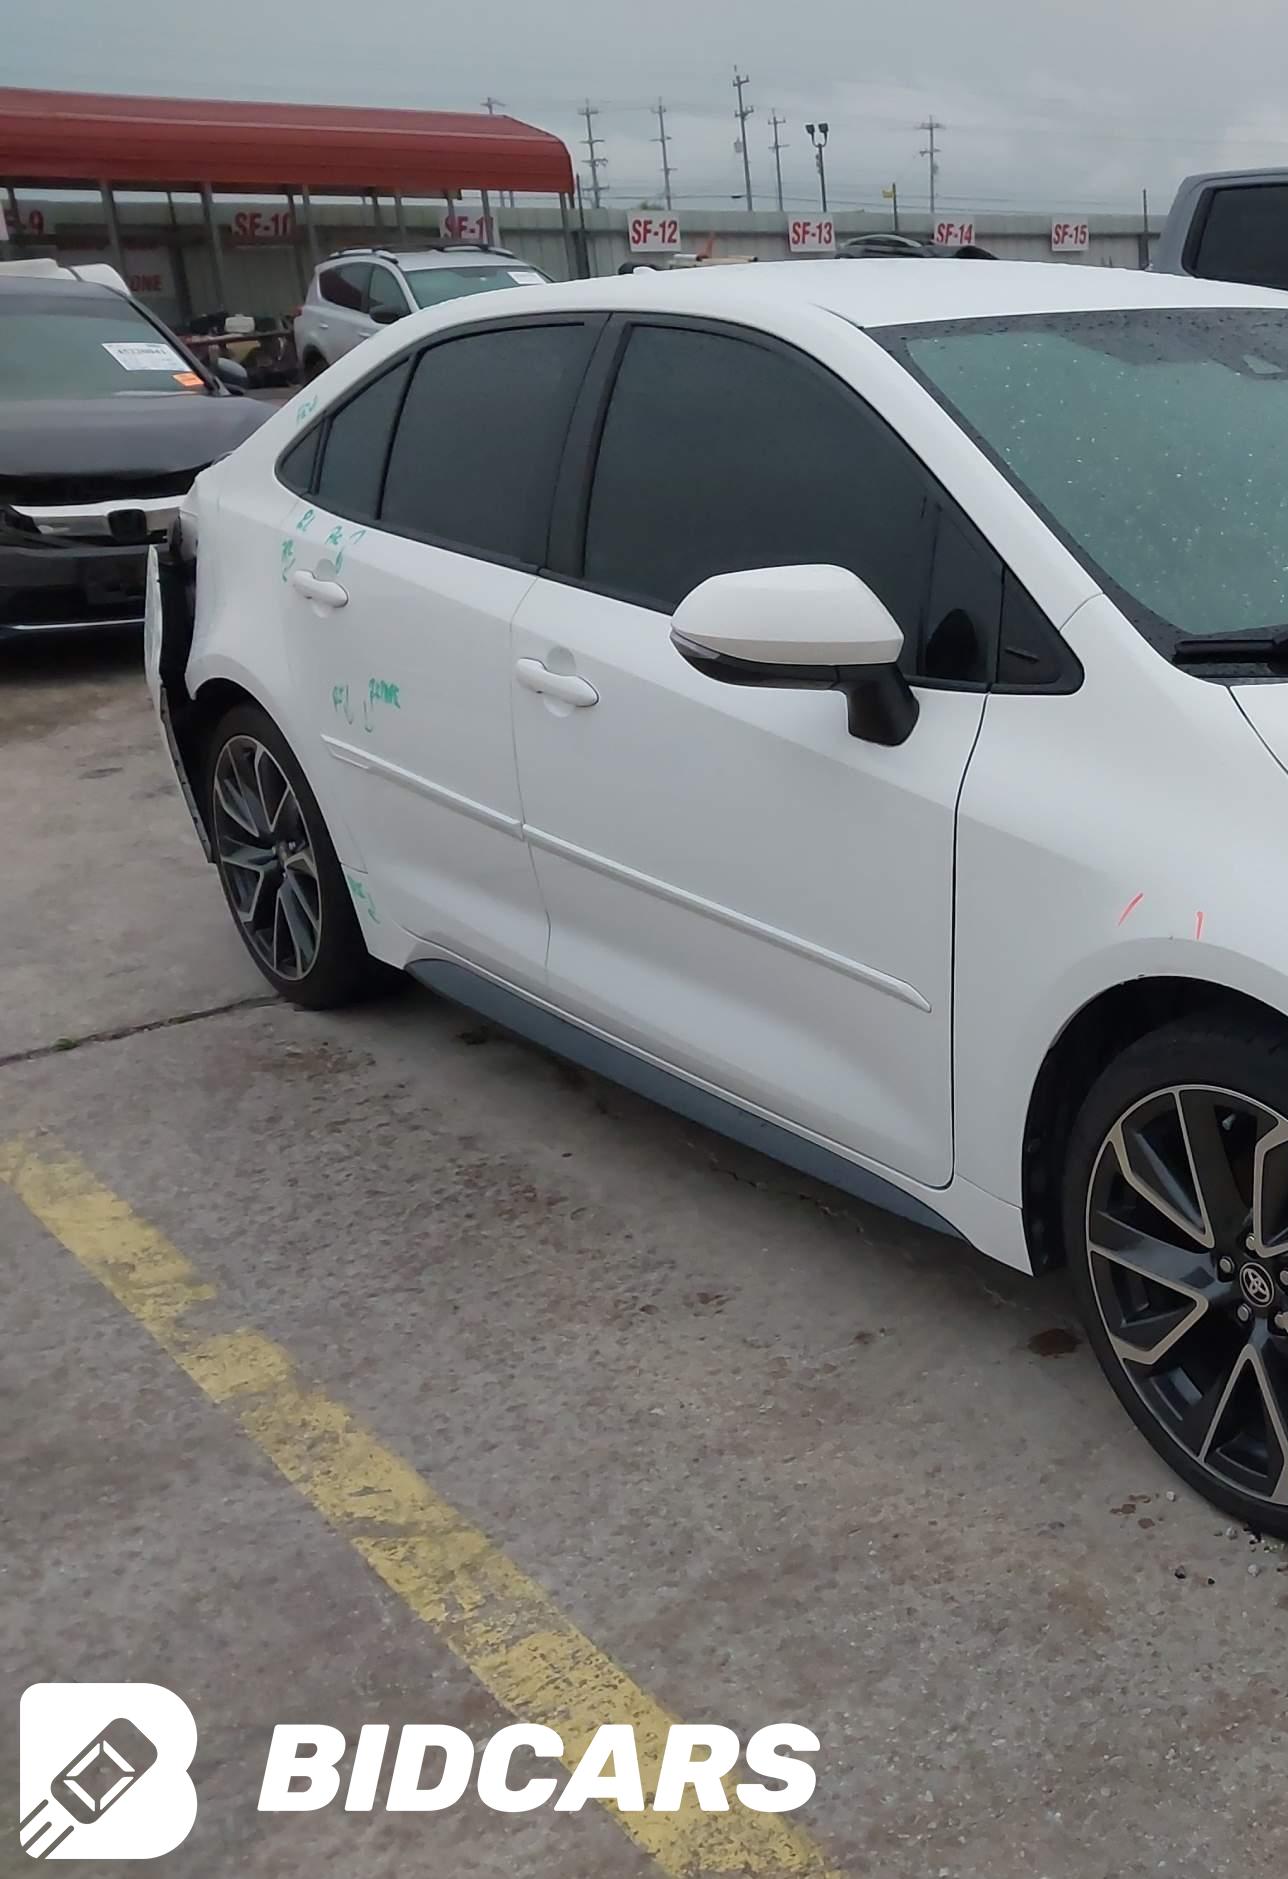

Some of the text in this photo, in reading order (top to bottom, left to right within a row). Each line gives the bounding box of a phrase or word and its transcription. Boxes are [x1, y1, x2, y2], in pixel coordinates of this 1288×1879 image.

[444, 214, 494, 240] SF-1
[631, 219, 678, 245] SF-12
[791, 221, 833, 245] SF-13
[936, 223, 973, 245] SF-14
[1053, 224, 1088, 245] SF-15
